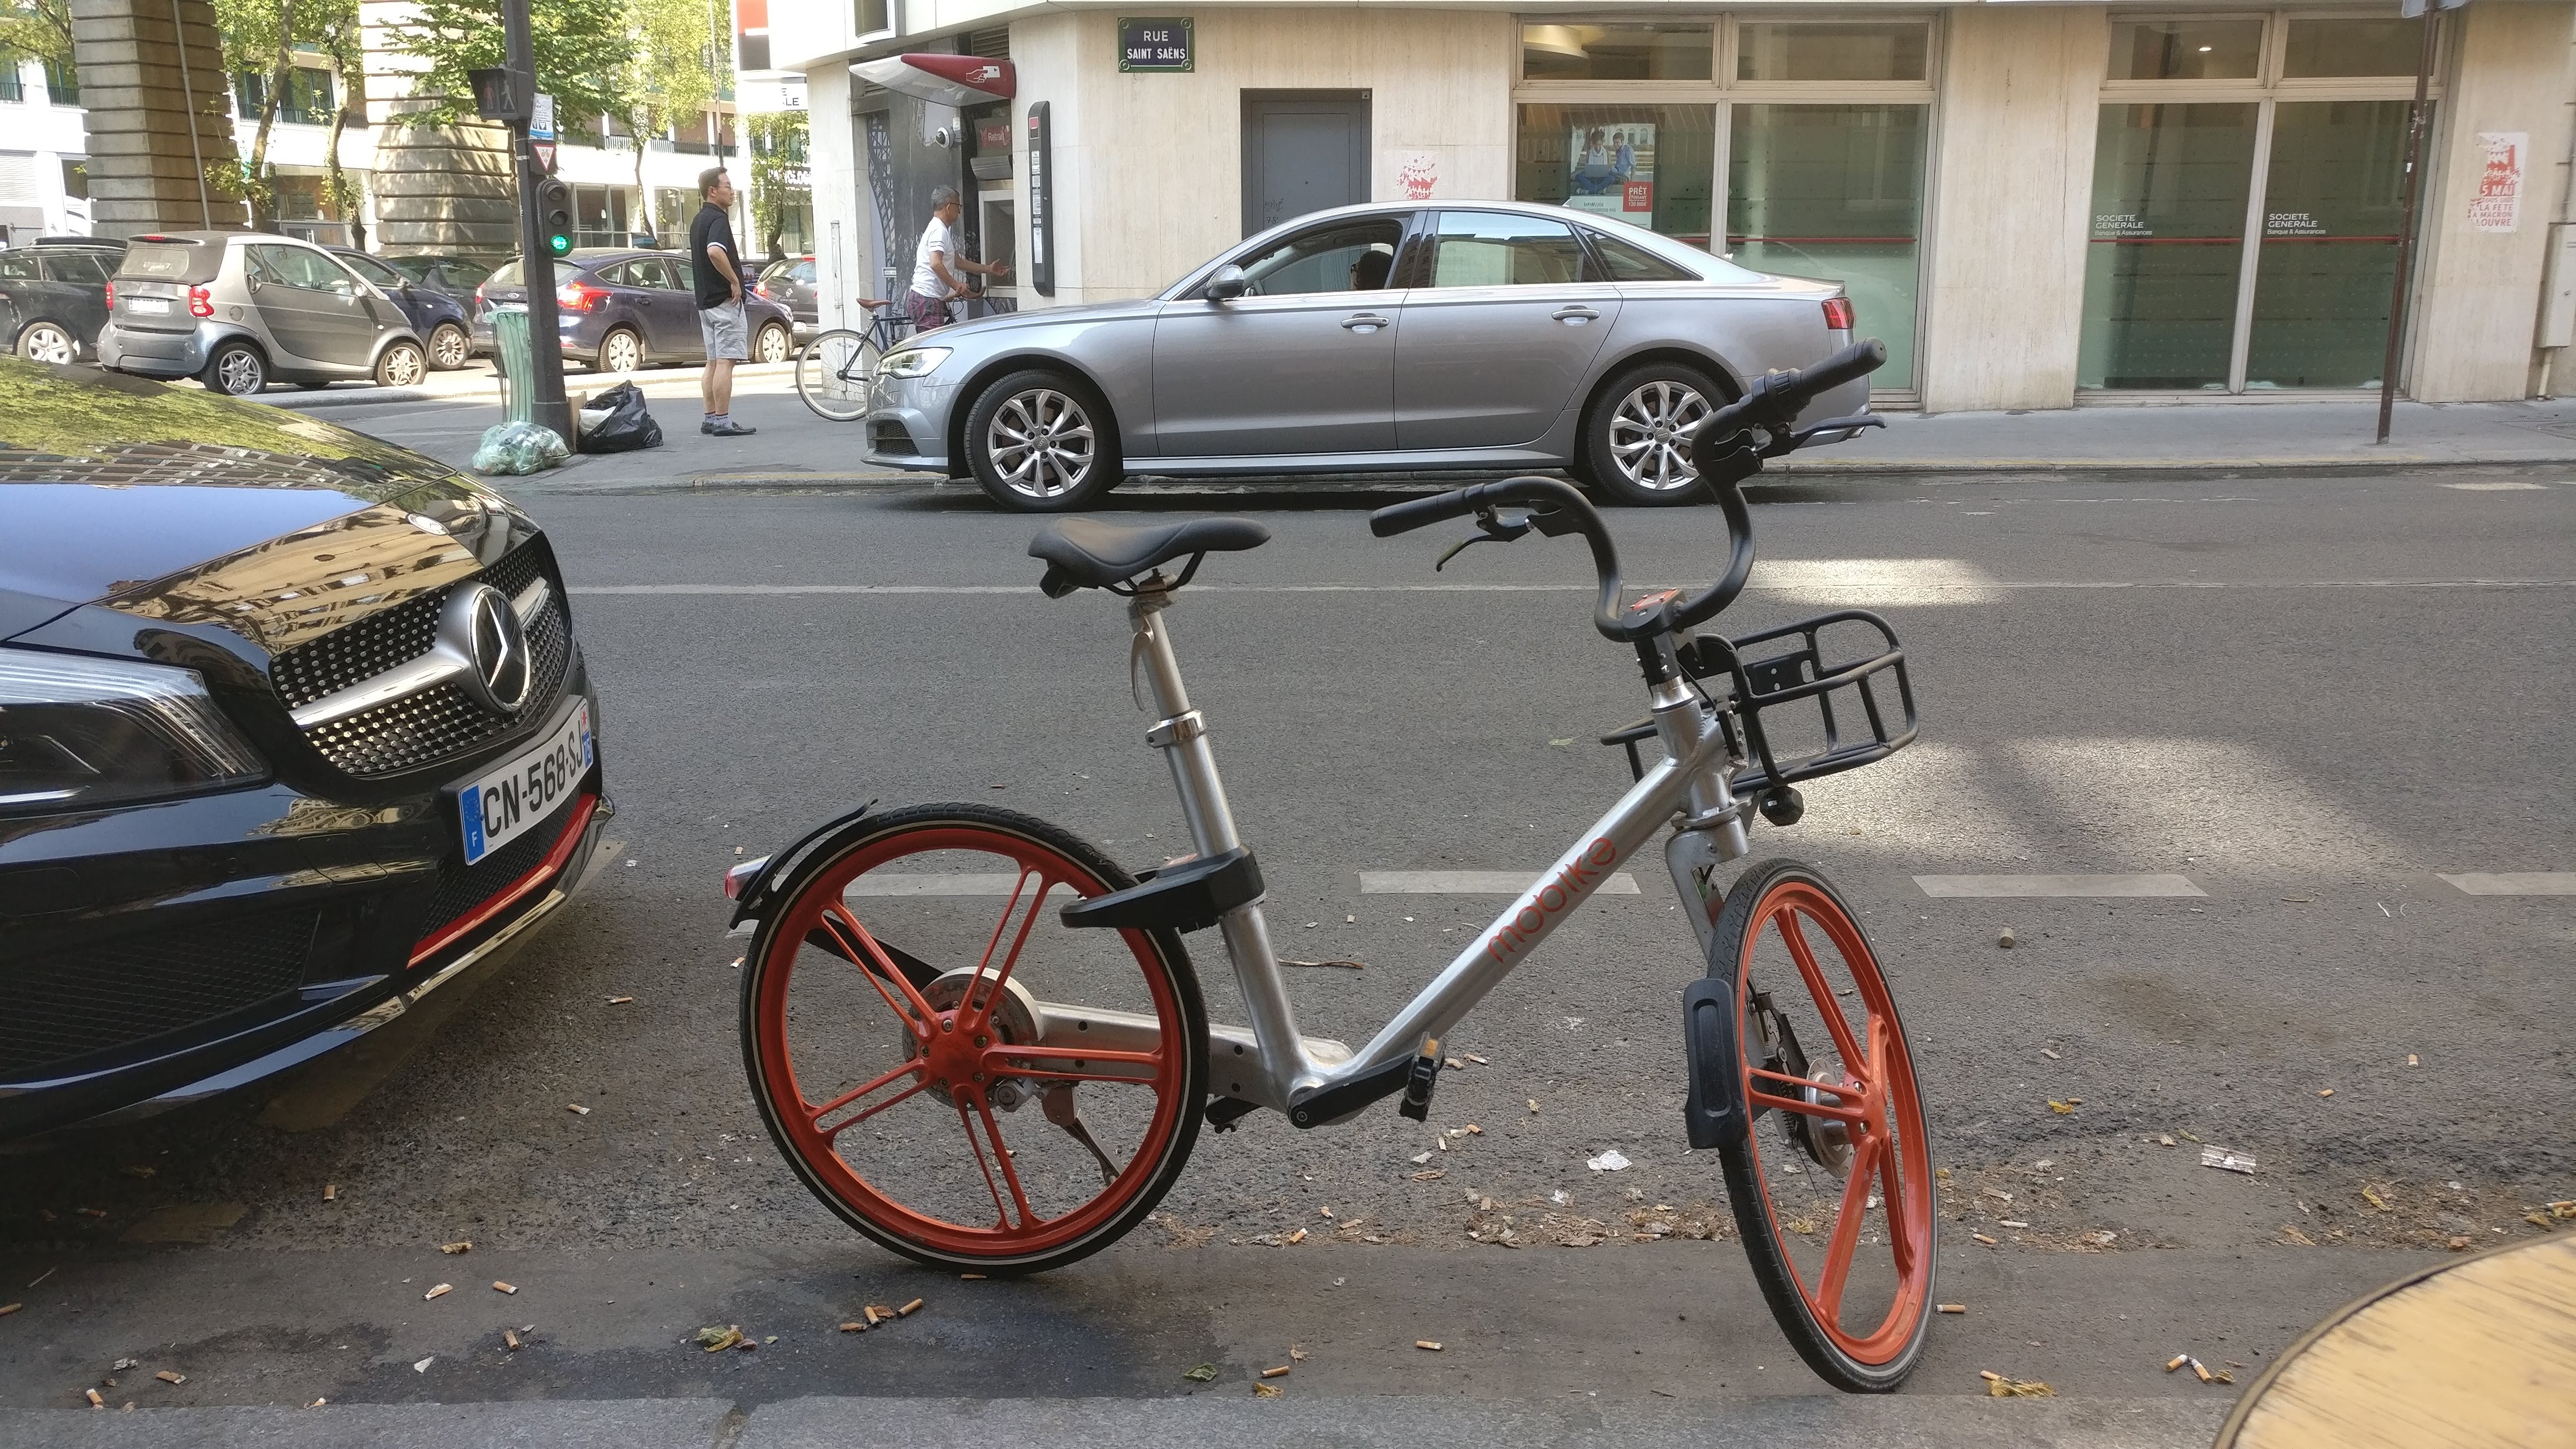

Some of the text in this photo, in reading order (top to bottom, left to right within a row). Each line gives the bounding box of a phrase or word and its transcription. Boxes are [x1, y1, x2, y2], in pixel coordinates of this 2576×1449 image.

[1144, 31, 1169, 42] RUE
[1127, 46, 1186, 59] SAINT SAËNS
[1629, 185, 1647, 195] PRÊT
[2481, 185, 2513, 195] 5 MAI
[471, 720, 592, 847] F CN-568-SJ 75
[1487, 837, 1617, 964] mobike
